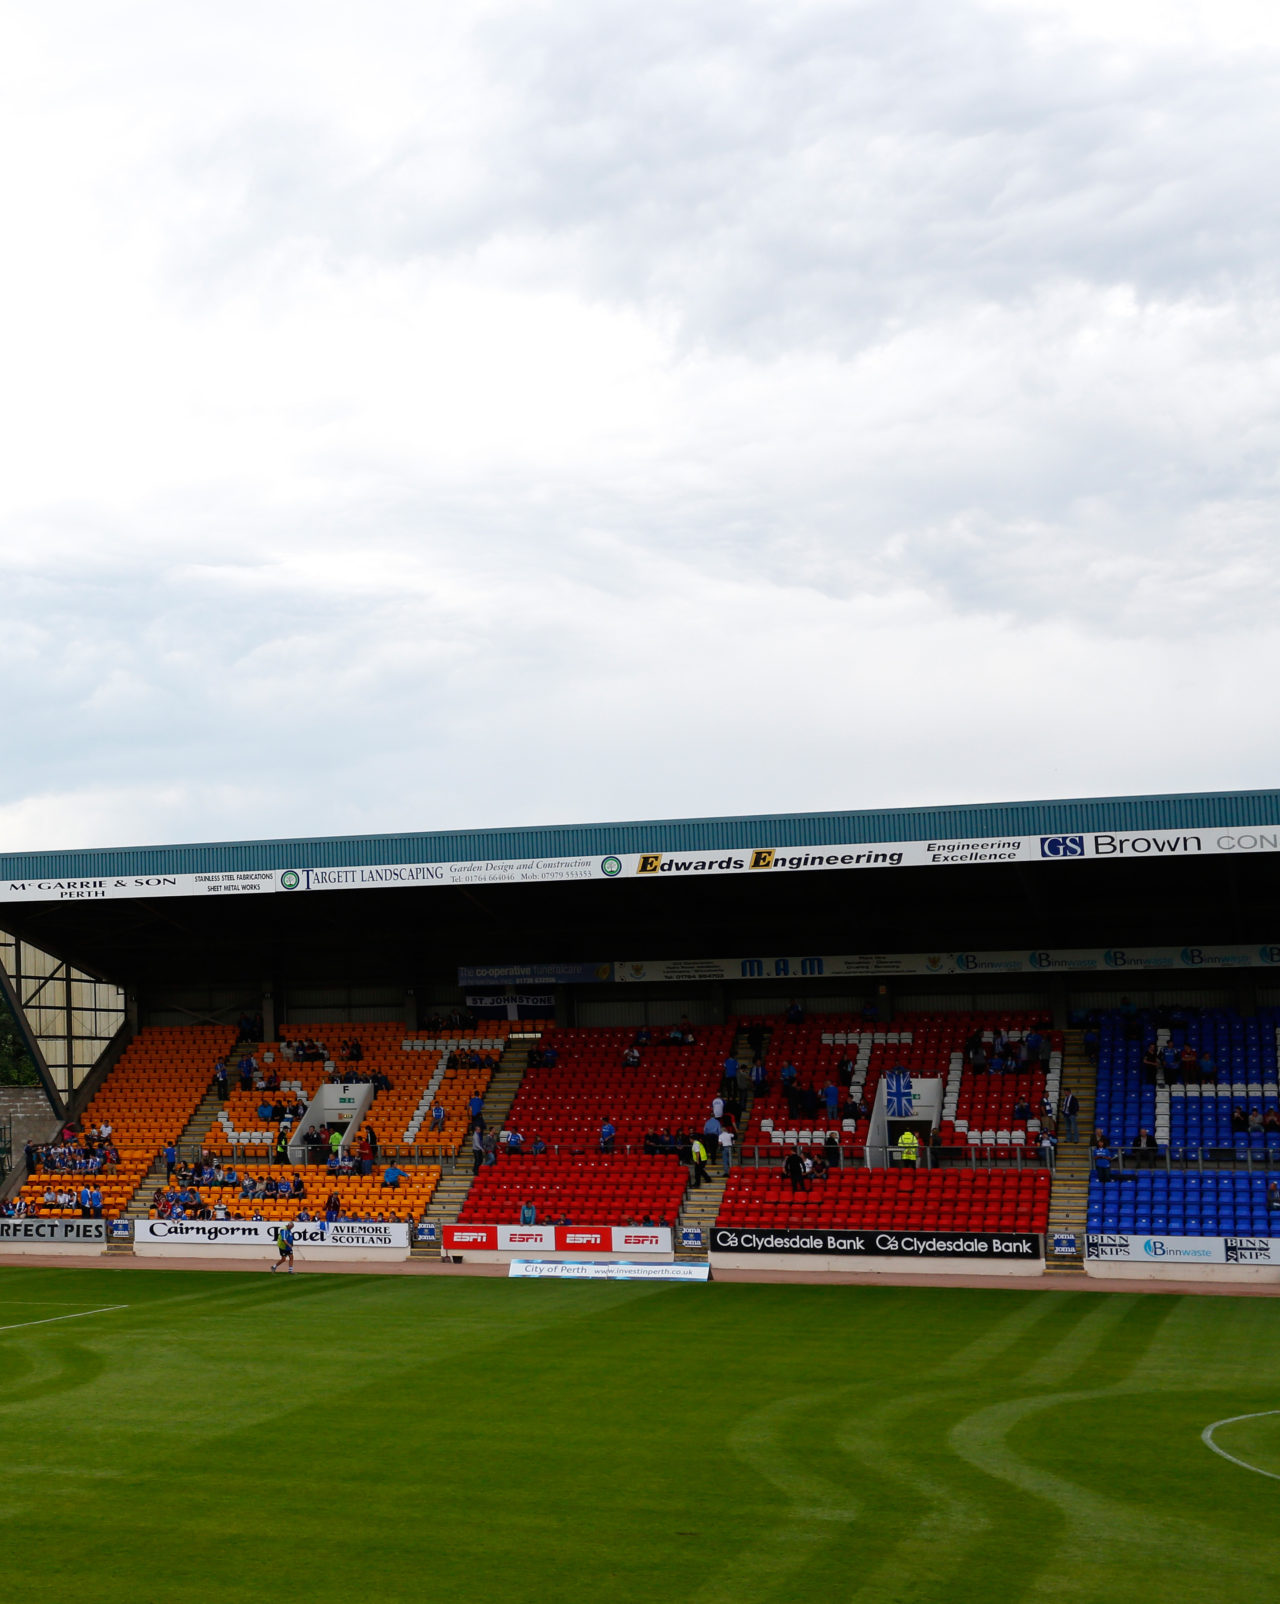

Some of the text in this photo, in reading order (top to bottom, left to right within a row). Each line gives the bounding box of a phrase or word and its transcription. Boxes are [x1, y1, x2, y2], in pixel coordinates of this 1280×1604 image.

[927, 840, 1021, 853] Engineering
[1043, 837, 1082, 857] GS
[1094, 835, 1202, 855] Brown
[638, 850, 903, 874] Edwards Engineering
[932, 852, 1016, 863] Excellence
[449, 859, 591, 874] Garden Design and Construction
[113, 879, 127, 888] &
[134, 877, 177, 887] SON
[194, 875, 220, 883] STAINLESS
[236, 873, 273, 881] FABRICATIONS
[302, 866, 443, 890] TARGETT LANDSCAPING
[223, 884, 238, 892] METAL
[60, 890, 105, 899] PERTH
[490, 996, 553, 1005] JOHNSTONE
[343, 1086, 349, 1094] F
[64, 1224, 103, 1238] PIES
[149, 1222, 260, 1242] Cairngorm
[331, 1225, 391, 1235] AVIEMORE
[331, 1236, 392, 1246] SCOTLAND
[453, 1232, 487, 1243] ESPN
[509, 1233, 543, 1243] ESPN
[566, 1233, 601, 1244] ESPN
[624, 1235, 659, 1245] ESPN
[740, 1233, 824, 1250] Clydesdale
[827, 1236, 866, 1251] Bank
[1088, 1235, 1129, 1244] BINN
[1226, 1238, 1269, 1248] BINN
[901, 1237, 988, 1254] Clydesdale
[992, 1239, 1032, 1254] Bank
[1153, 1241, 1213, 1257] Binnwaste
[1088, 1247, 1130, 1258] SKIPS
[1227, 1250, 1271, 1261] SKIPS
[524, 1264, 694, 1277] City of Perth www.investinperth.co.uk
